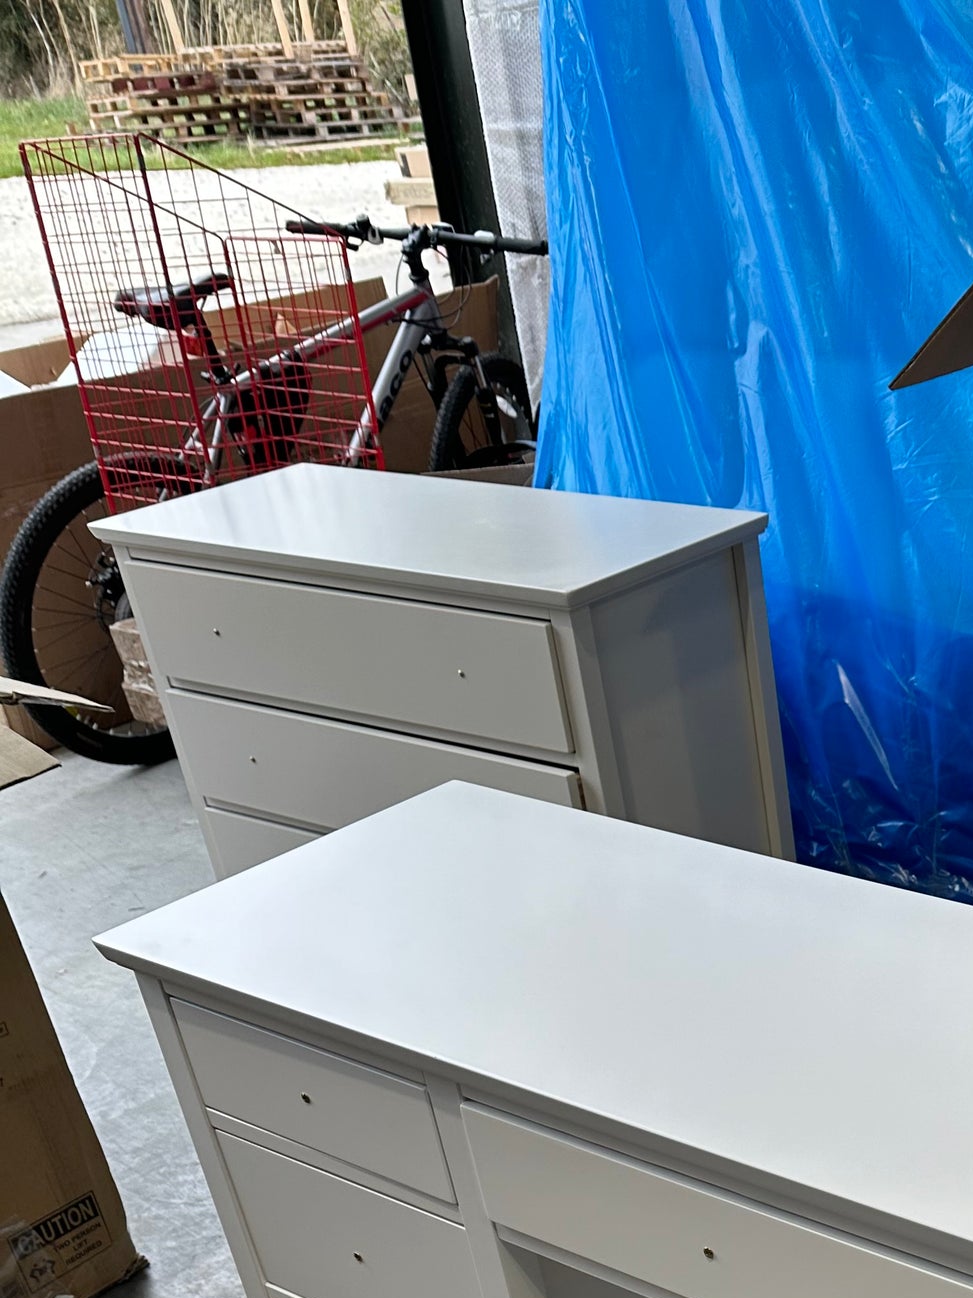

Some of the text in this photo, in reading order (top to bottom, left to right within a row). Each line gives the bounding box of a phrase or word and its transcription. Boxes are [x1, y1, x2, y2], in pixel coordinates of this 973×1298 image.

[18, 1199, 95, 1253] CAUTION
[54, 1222, 101, 1252] TWO PERSON
[66, 1240, 102, 1265] REQUIRED
[73, 1239, 88, 1251] LIFT
